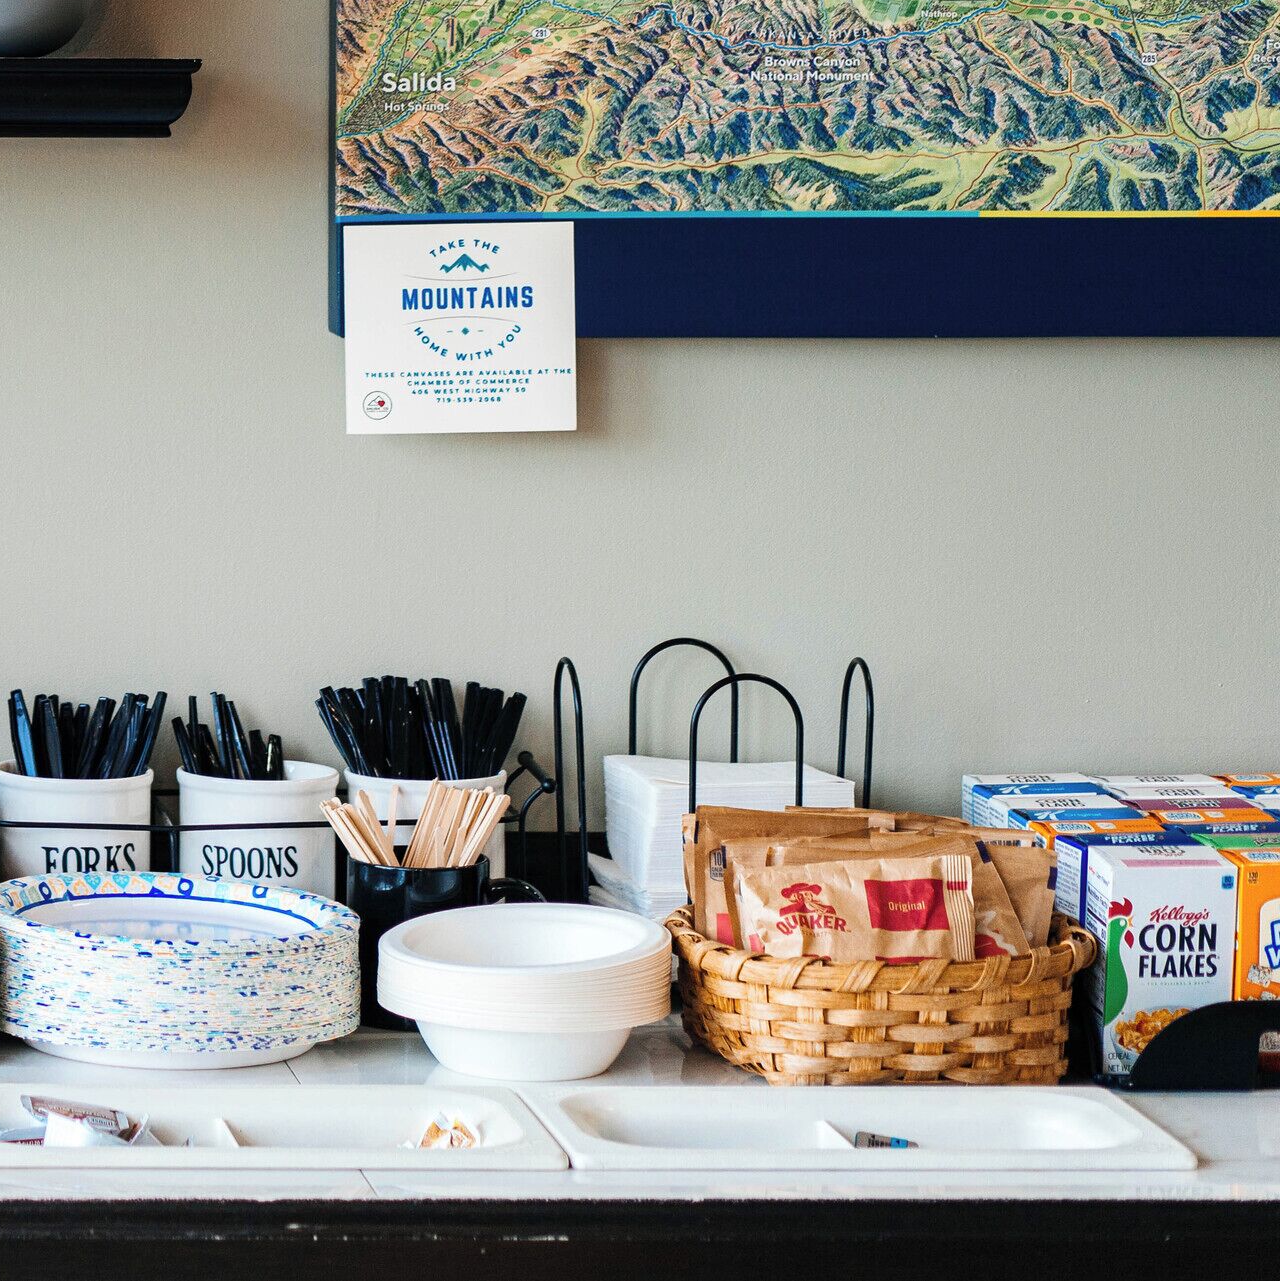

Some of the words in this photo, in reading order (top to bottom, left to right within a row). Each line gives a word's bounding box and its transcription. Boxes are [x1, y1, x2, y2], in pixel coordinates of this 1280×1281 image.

[921, 10, 958, 19] Nathrop
[749, 27, 824, 41] ARKANSAS
[829, 26, 870, 40] RIVER
[764, 56, 811, 68] Browns
[813, 56, 861, 70] Canyon
[1142, 54, 1156, 64] 285
[382, 72, 456, 92] Salida
[750, 71, 803, 82] National
[806, 71, 874, 81] Monument
[384, 102, 405, 112] Hot
[407, 102, 450, 114] Springs
[429, 239, 465, 258] TAKE
[473, 239, 500, 254] THE
[402, 285, 534, 310] MOUNTAINS
[413, 326, 449, 357] HOME
[455, 348, 493, 361] WITH
[497, 324, 522, 349] YOU
[407, 379, 454, 387] CHAMBER
[41, 843, 136, 874] FORKS
[202, 844, 298, 879] SPOONS
[888, 901, 926, 913] Original
[1149, 905, 1211, 926] Kellogg's
[776, 914, 847, 935] QUAKER
[1138, 923, 1218, 953] CORN
[1138, 954, 1218, 978] FLAKES
[1107, 1052, 1131, 1060] CEREAL
[1107, 1064, 1120, 1072] NET
